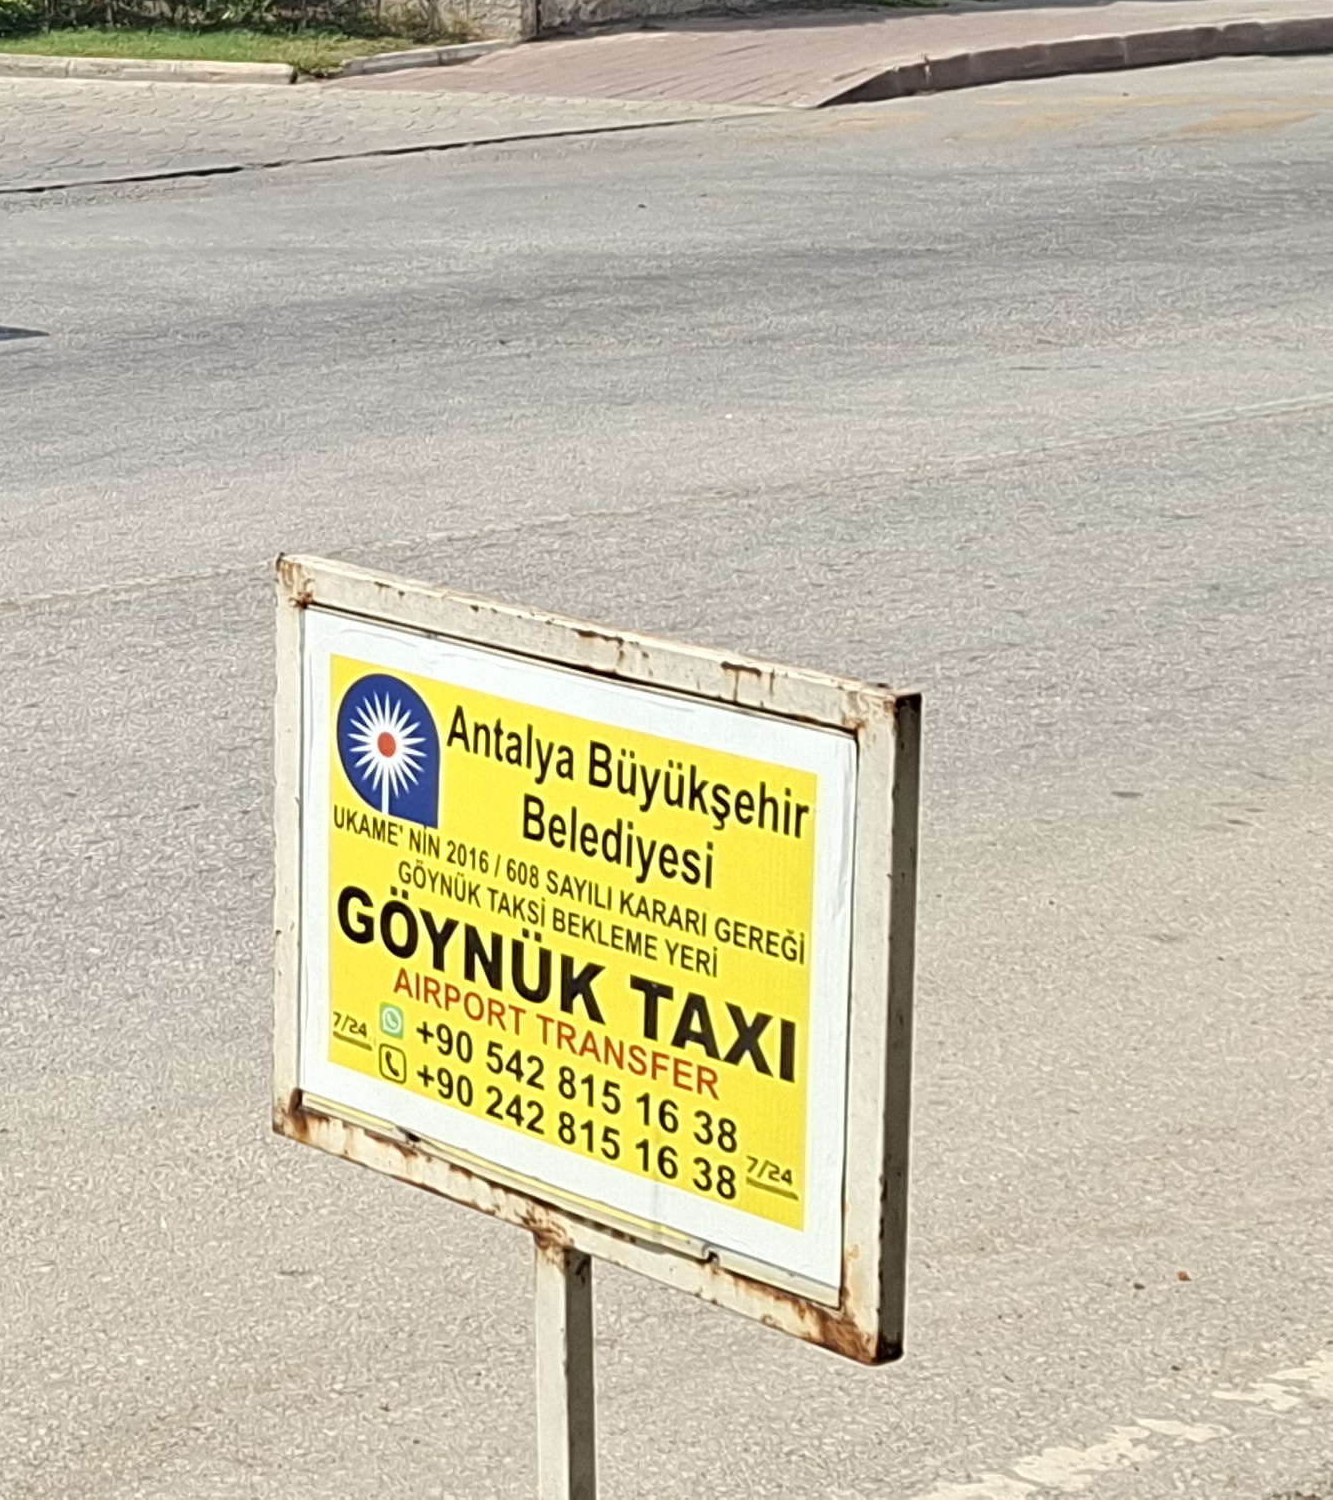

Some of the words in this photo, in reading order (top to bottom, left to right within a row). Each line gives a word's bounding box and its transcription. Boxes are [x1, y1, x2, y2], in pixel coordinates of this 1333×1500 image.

[446, 704, 574, 785] Antalya
[588, 739, 810, 839] Büyükşehir
[446, 840, 490, 874] 2016
[494, 853, 501, 878] /
[506, 858, 539, 889] 608
[545, 868, 612, 912] SAYILI
[619, 888, 707, 938] KARARI
[714, 916, 805, 966] GEREĞİ
[522, 792, 714, 889] Belediyesi
[337, 884, 607, 1026] GÖYNÜK
[629, 973, 796, 1084] TAXI
[398, 859, 482, 909] GÖYNÜK
[486, 886, 546, 928] TAKSİ
[552, 906, 659, 961] BEKLEME
[664, 938, 719, 978] YERİ
[393, 966, 527, 1036] AIRPORT
[535, 1012, 720, 1102] TRANSFER
[416, 1021, 474, 1064] +90
[485, 1040, 545, 1091] 542
[558, 1065, 621, 1115] 815
[635, 1092, 679, 1134] 16
[693, 1109, 738, 1153] 38
[416, 1064, 474, 1108] +90
[485, 1085, 545, 1136] 242
[557, 1110, 621, 1161] 815
[635, 1138, 679, 1180] 16
[692, 1156, 737, 1200] 38
[745, 1155, 794, 1187] 7/24
